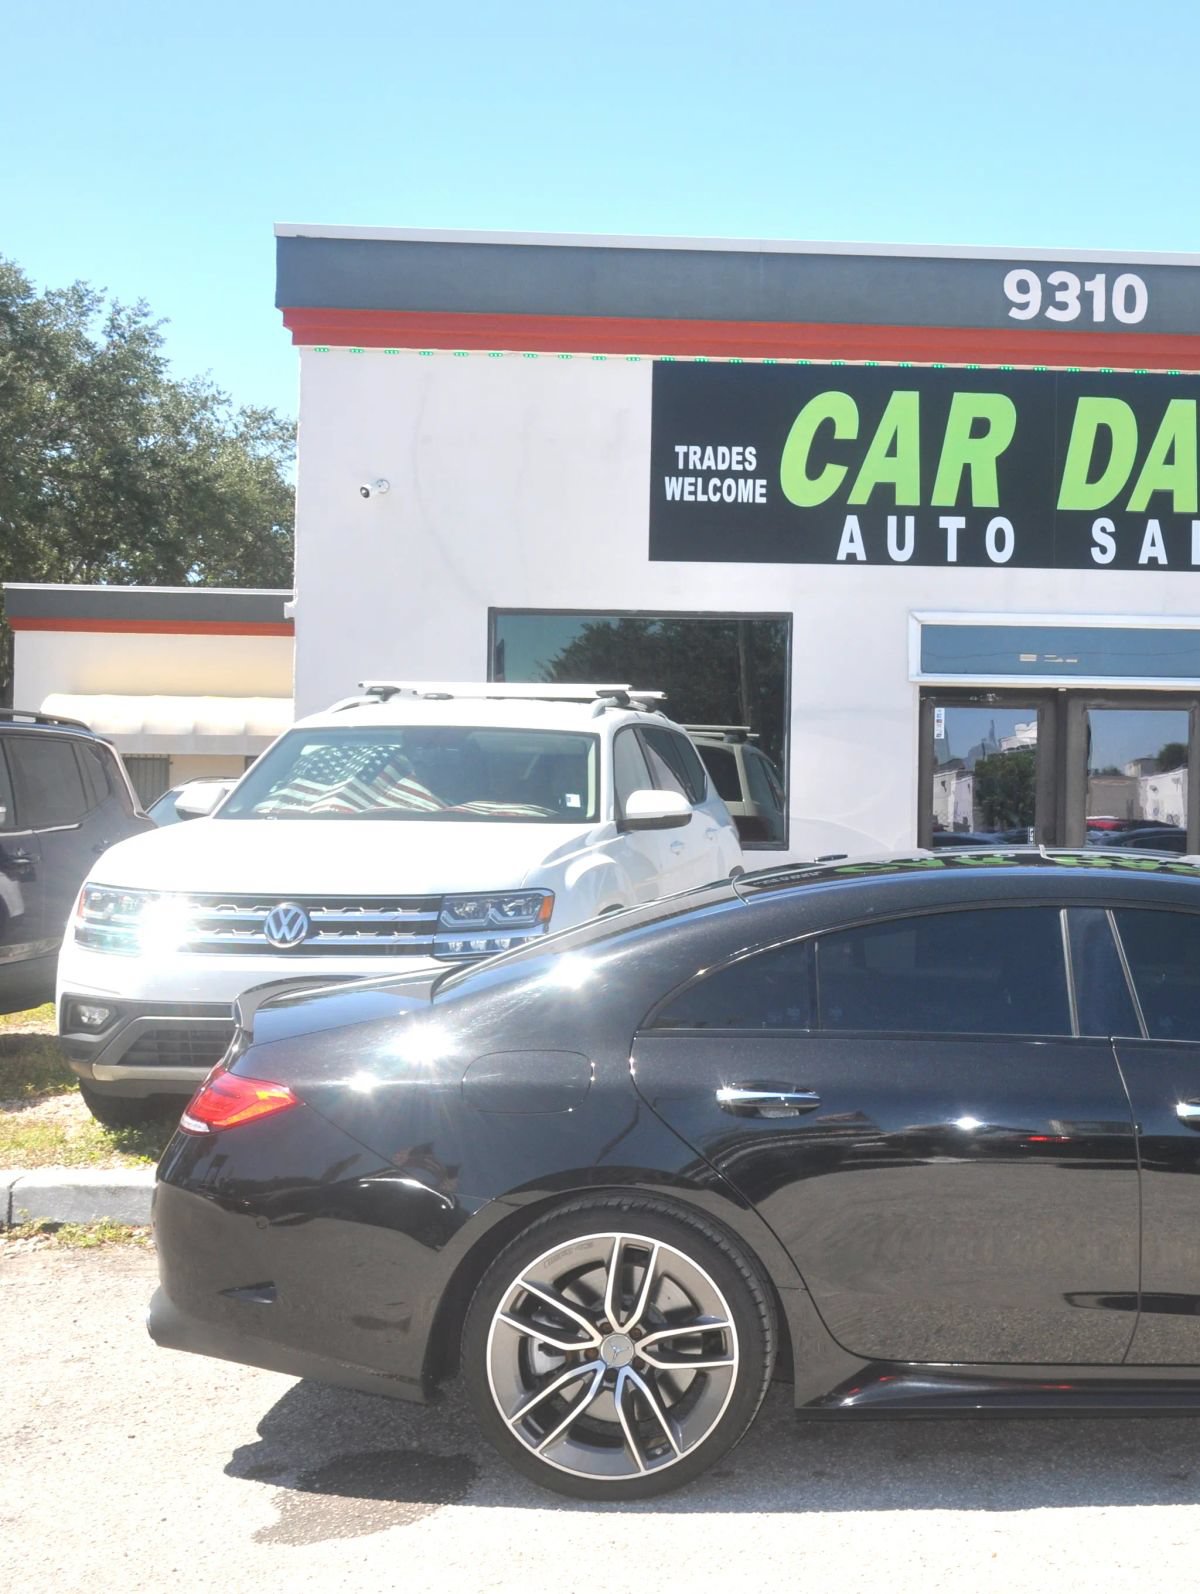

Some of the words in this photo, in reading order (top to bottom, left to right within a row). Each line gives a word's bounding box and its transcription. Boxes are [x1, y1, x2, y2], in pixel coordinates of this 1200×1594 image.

[1003, 268, 1149, 324] 9310
[674, 445, 758, 472] TRADES
[779, 389, 1017, 508] CAR
[664, 476, 768, 504] WELCOME
[835, 514, 1016, 564] AUTO
